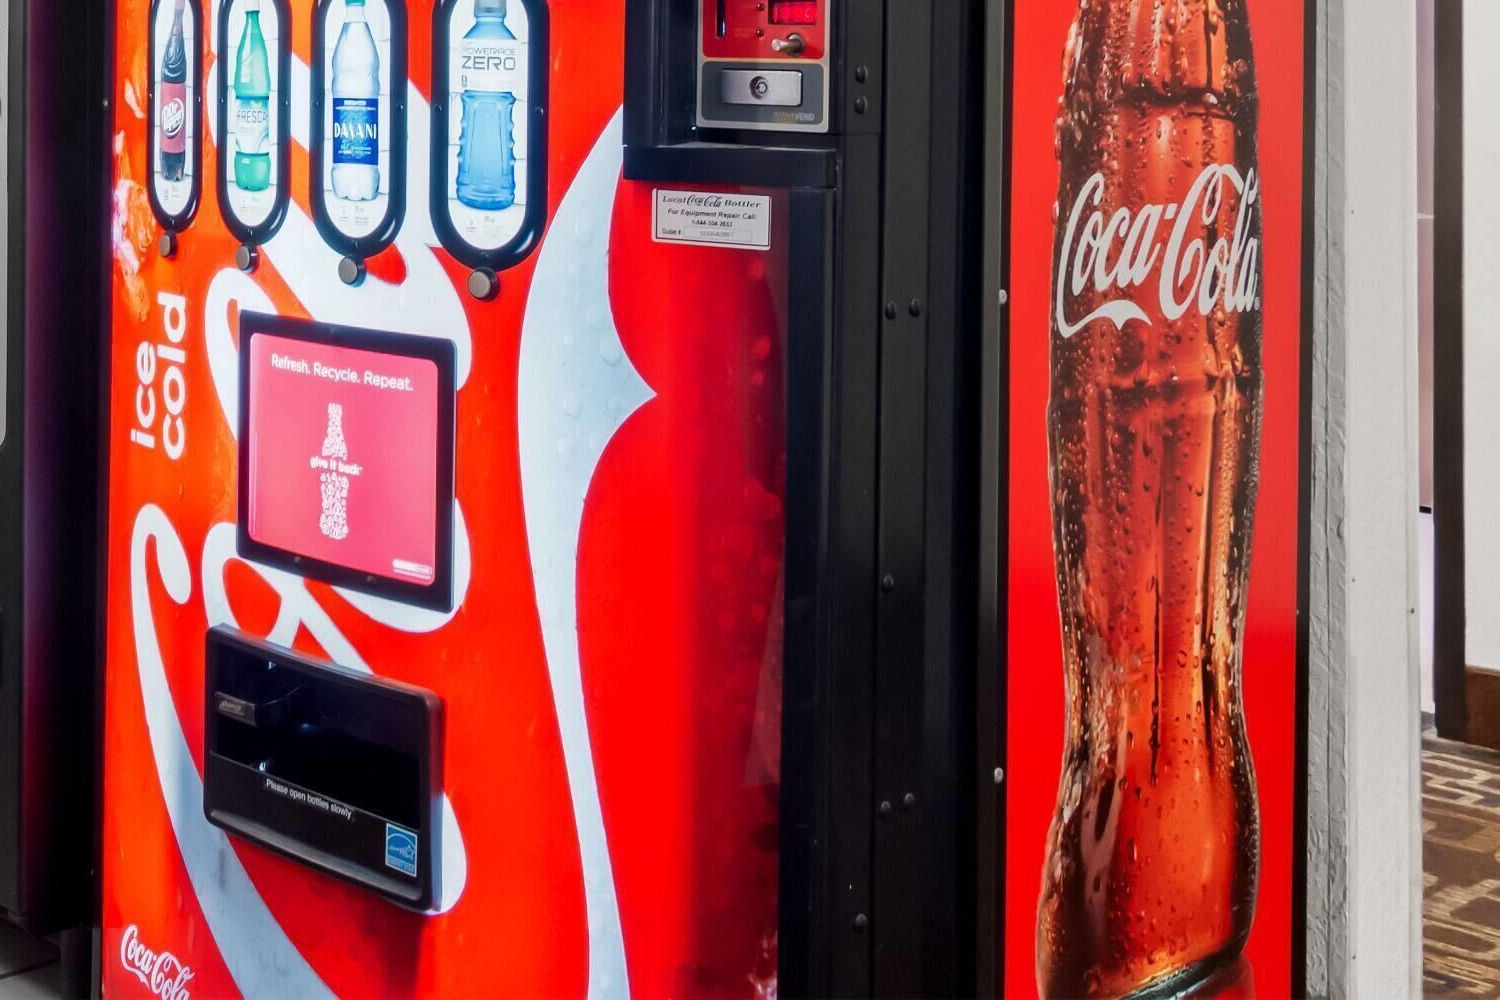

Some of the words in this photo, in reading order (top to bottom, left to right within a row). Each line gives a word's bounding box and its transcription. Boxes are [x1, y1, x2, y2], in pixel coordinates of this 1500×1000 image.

[462, 56, 516, 70] ZERO
[236, 110, 268, 123] FRESCA
[334, 120, 377, 140] DASANI
[681, 209, 716, 217] Equipment
[724, 199, 760, 208] Bottler
[1055, 163, 1260, 339] Coca-Cola
[157, 291, 186, 461] cold
[271, 353, 311, 375] Refresh.
[313, 362, 360, 383] Recycle.
[364, 371, 414, 392] Repeat.
[130, 341, 156, 449] ice
[310, 456, 329, 469] give
[266, 778, 288, 794] Please
[289, 788, 306, 800] open
[307, 793, 329, 810] bottles
